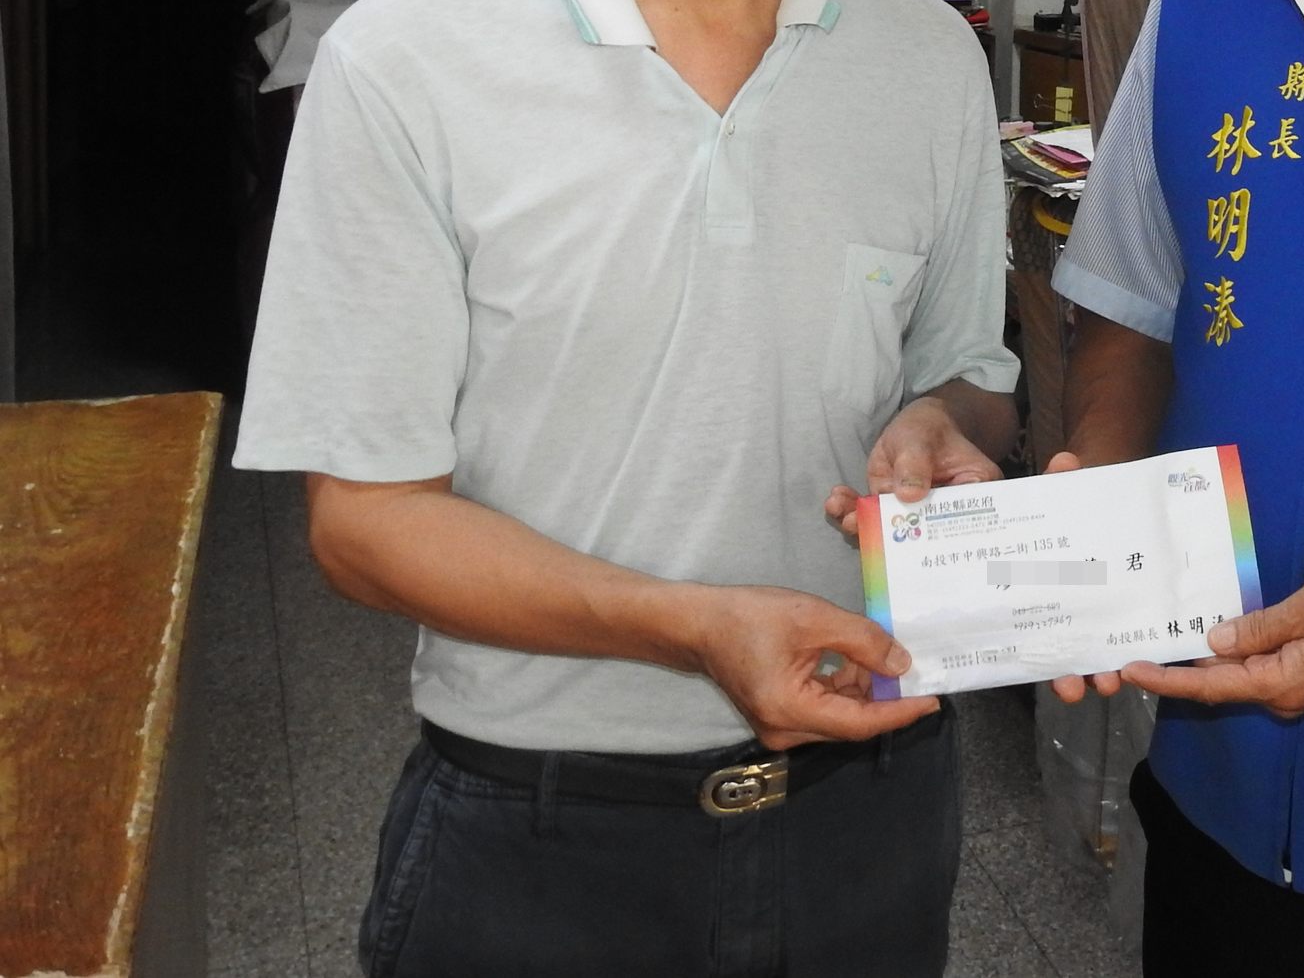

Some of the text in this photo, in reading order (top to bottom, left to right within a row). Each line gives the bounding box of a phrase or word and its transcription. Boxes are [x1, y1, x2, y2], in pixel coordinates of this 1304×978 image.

[924, 495, 994, 515] 南投縣政府
[1126, 552, 1144, 572] 君
[1106, 627, 1159, 646] 南投縣長
